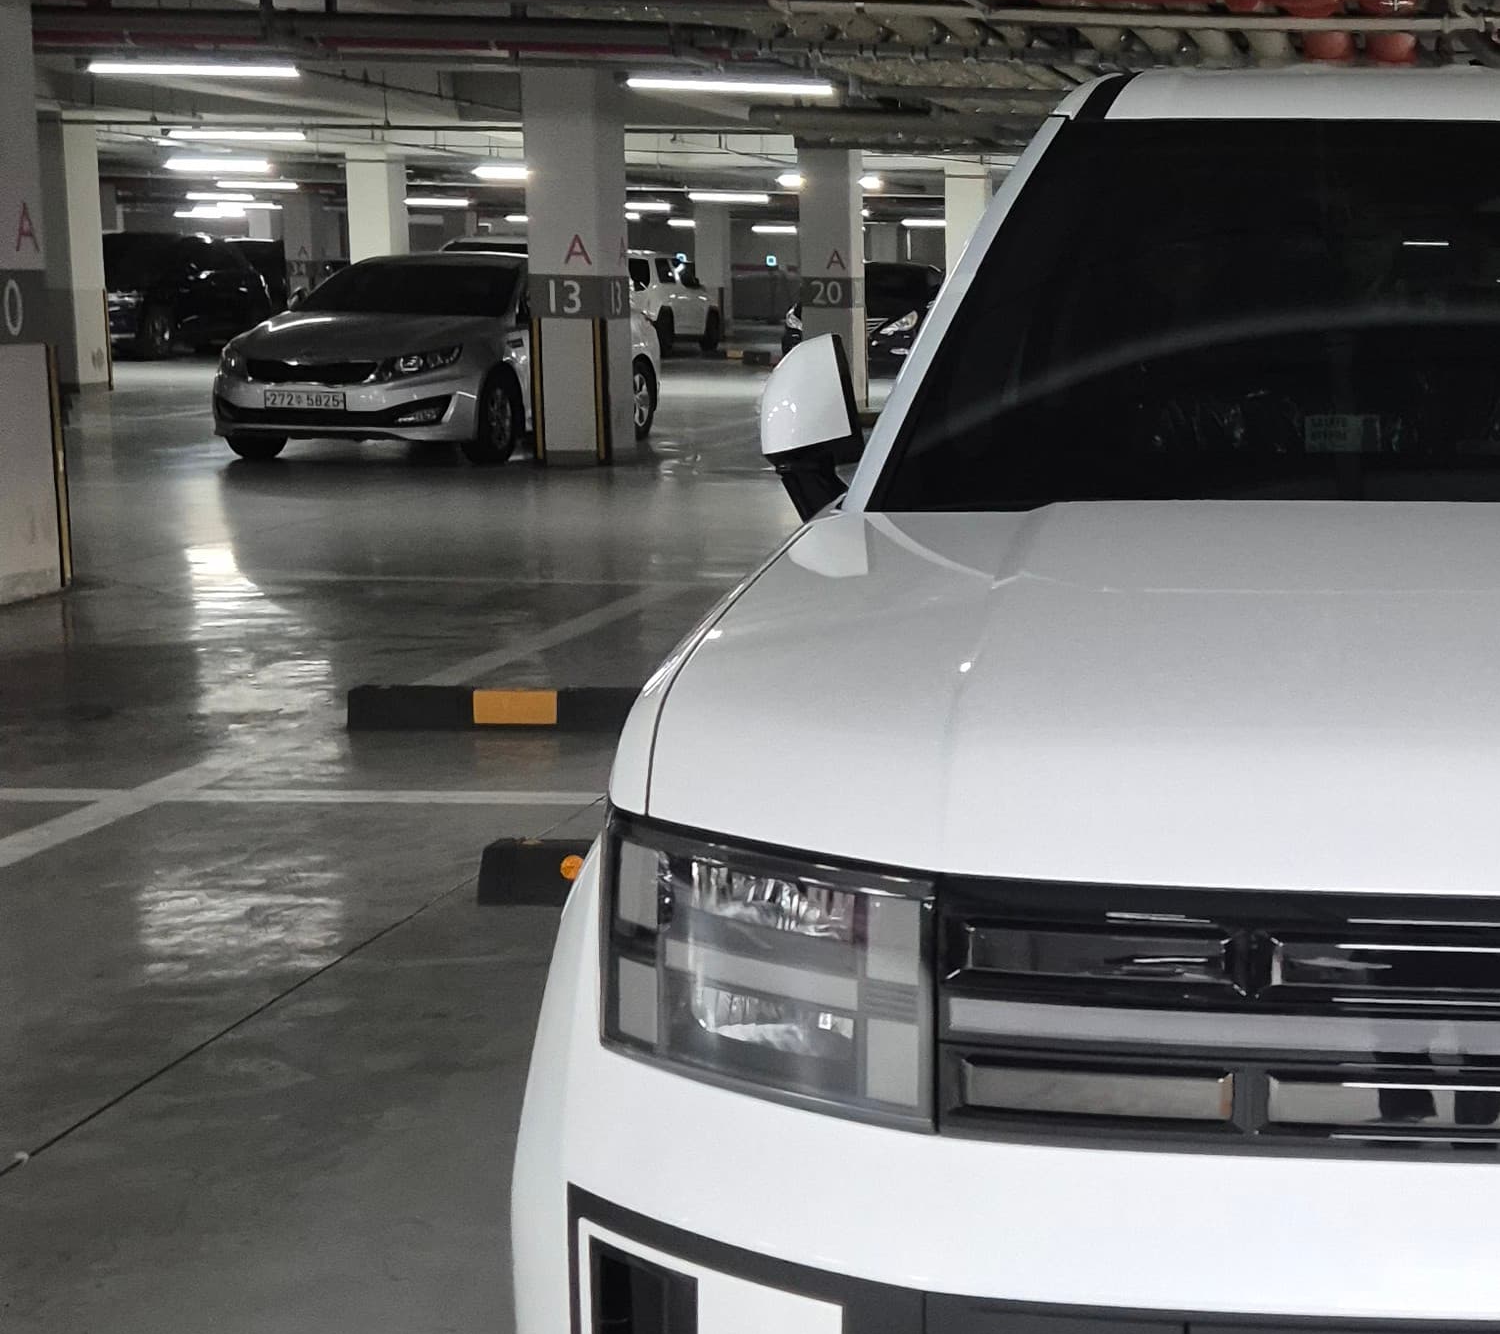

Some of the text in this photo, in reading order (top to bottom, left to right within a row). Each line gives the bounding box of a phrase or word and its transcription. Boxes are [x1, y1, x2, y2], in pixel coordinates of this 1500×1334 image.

[16, 202, 40, 253] A
[564, 234, 592, 265] A
[826, 250, 846, 270] A
[549, 279, 581, 314] 13
[811, 280, 842, 304] 20
